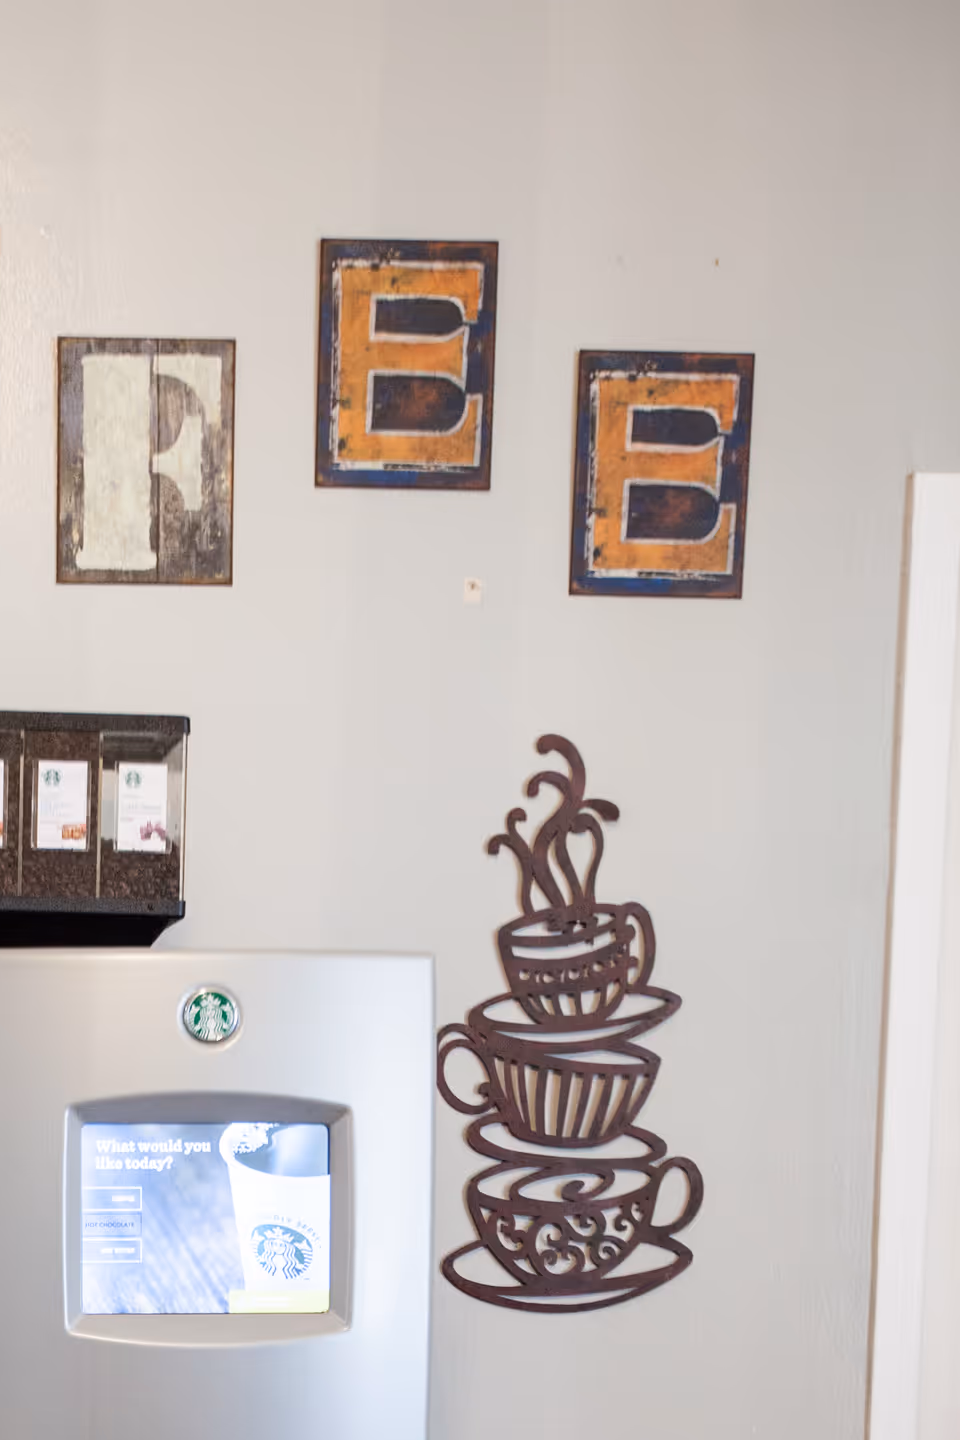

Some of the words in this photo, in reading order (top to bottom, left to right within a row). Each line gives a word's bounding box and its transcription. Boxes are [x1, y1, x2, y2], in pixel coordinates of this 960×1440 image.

[96, 1139, 136, 1153] What
[137, 1138, 183, 1153] would
[184, 1141, 211, 1155] you
[95, 1156, 123, 1169] like
[125, 1156, 173, 1172] today?
